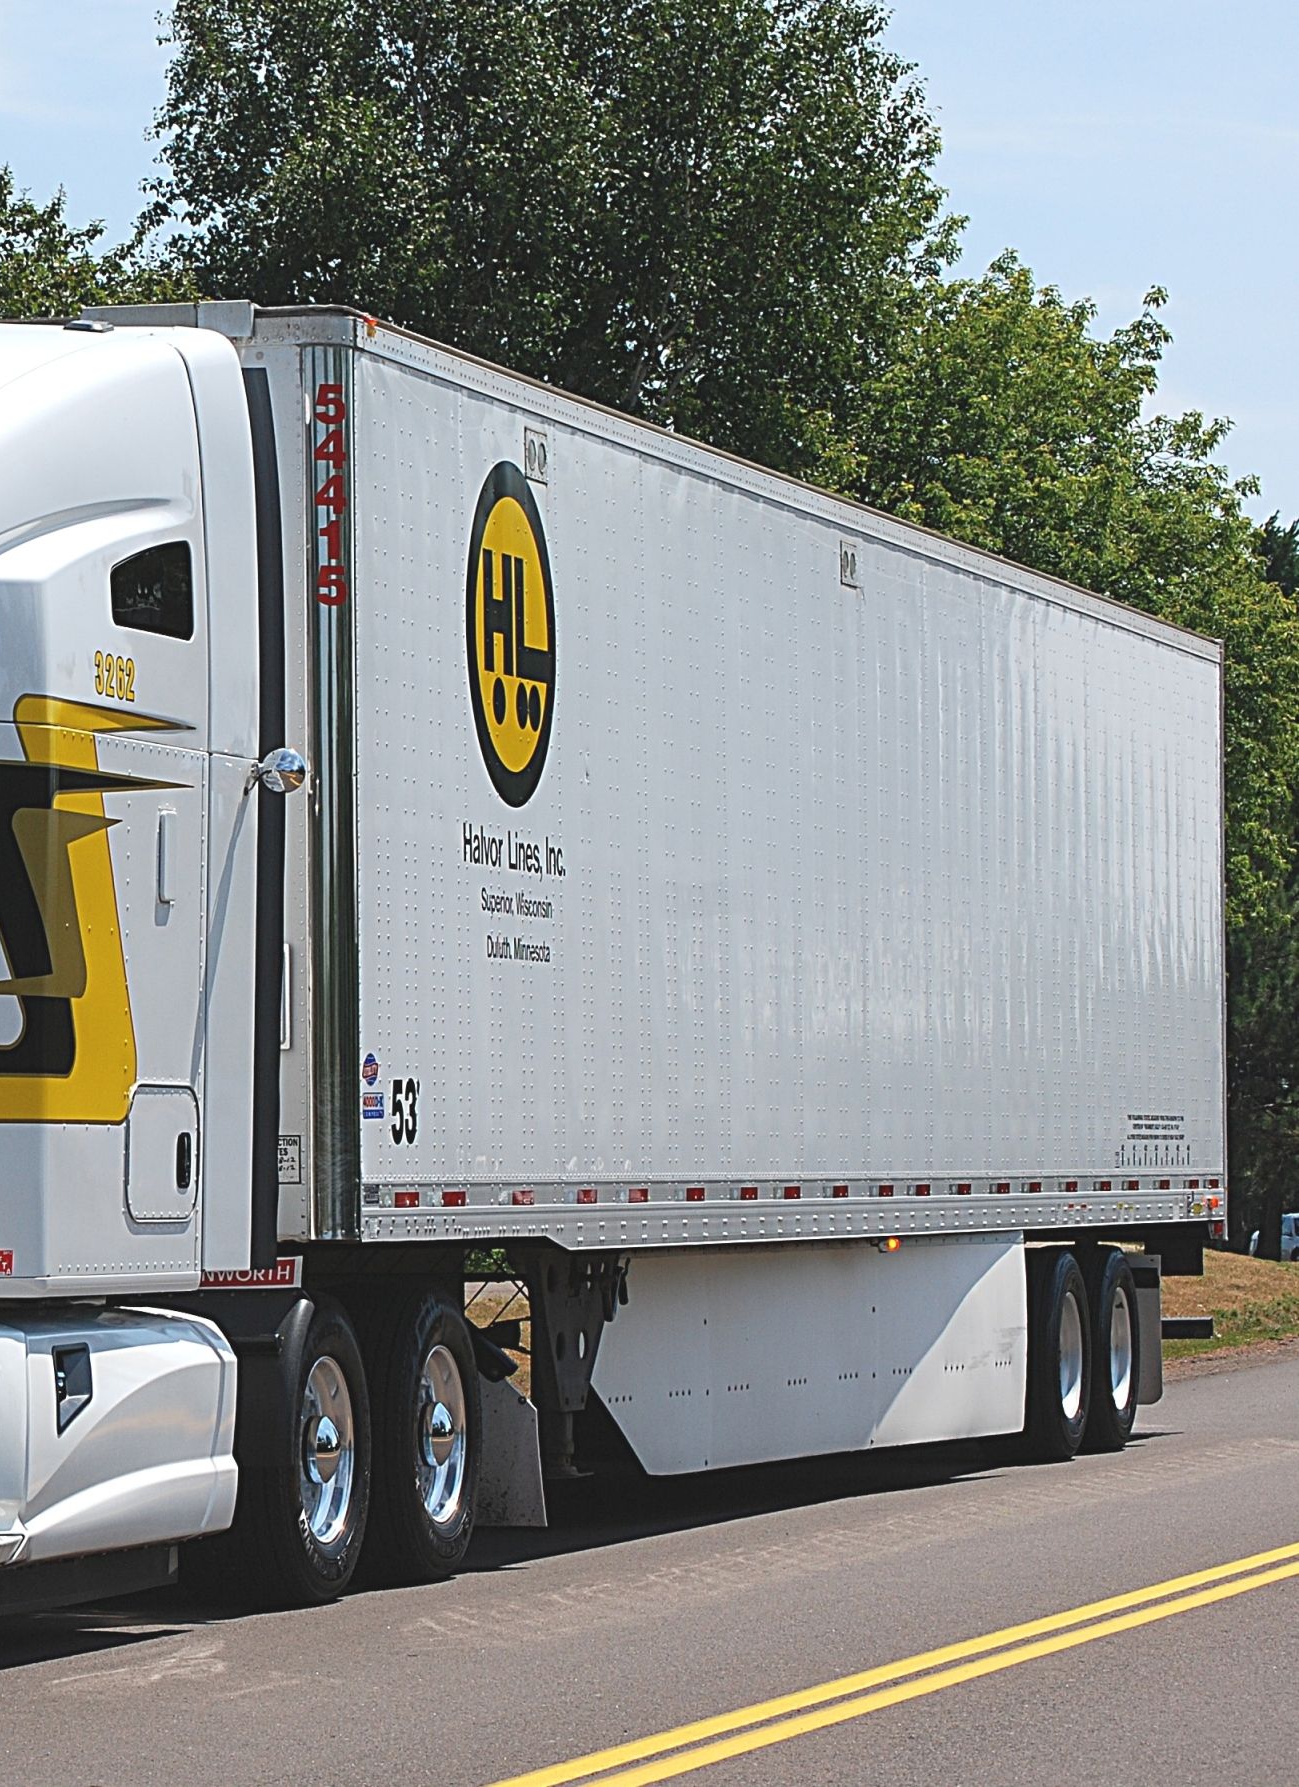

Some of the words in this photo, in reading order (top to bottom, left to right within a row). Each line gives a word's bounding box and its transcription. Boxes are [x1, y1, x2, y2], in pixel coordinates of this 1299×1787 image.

[314, 383, 347, 606] 54415
[483, 548, 550, 682] HL
[95, 650, 135, 702] 3262
[463, 822, 503, 867] Halvor
[508, 831, 543, 882] Lines,
[545, 837, 566, 876] Inc.
[481, 887, 514, 916] Superior,
[515, 892, 553, 919] Wisconsin
[514, 937, 551, 963] Minnesota
